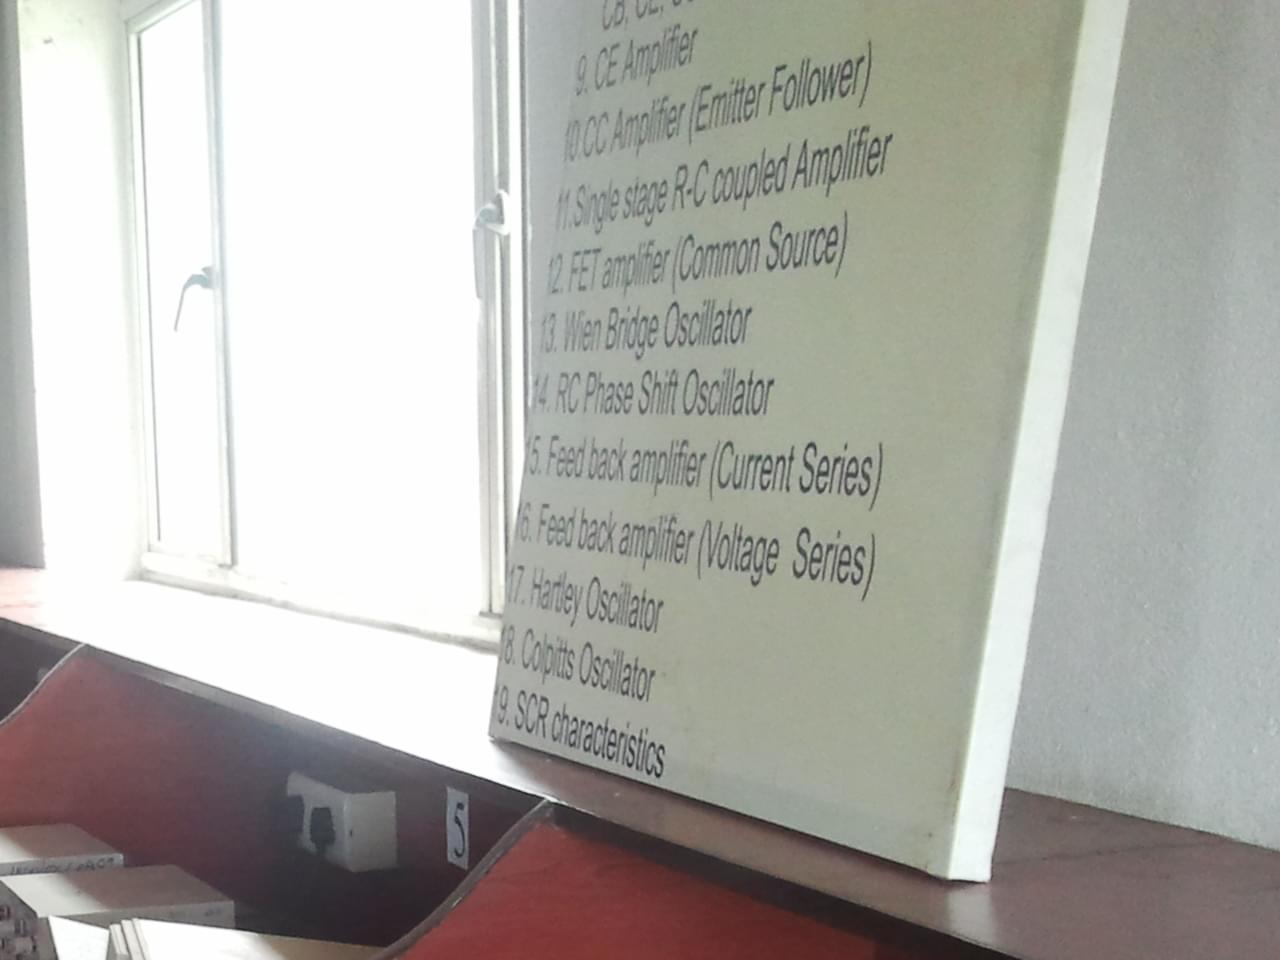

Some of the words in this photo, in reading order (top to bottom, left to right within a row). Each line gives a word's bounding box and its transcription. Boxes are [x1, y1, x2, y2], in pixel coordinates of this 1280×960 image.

[576, 55, 588, 96] 9.
[595, 44, 620, 90] CE
[622, 23, 698, 85] Amplifier
[611, 95, 686, 156] Amplifier
[689, 77, 766, 144] (Emitter
[768, 39, 872, 116] Follower)
[623, 177, 668, 227] stage
[672, 159, 709, 211] R-C
[712, 142, 791, 211] coupled
[791, 124, 894, 198] Amplifier
[568, 248, 602, 293] FET
[602, 239, 671, 296] amplifier
[672, 233, 760, 294] (Common
[765, 210, 848, 278] Source)
[564, 310, 602, 352] Wien
[605, 305, 659, 360] Bridge
[664, 299, 752, 348] Oscillator
[557, 371, 581, 414] RC
[584, 371, 633, 415] Phase
[638, 369, 678, 415] Shift
[683, 368, 775, 415] Oscillator
[546, 435, 587, 477] Feed
[588, 436, 626, 481] back
[629, 439, 708, 497] amplifier
[710, 440, 795, 501] (Current
[799, 441, 883, 512] Series)
[537, 503, 578, 548] Feed
[578, 507, 617, 554] back
[620, 514, 695, 571] amplifier
[698, 519, 780, 587] (Voltage
[792, 526, 876, 602] Series)
[529, 567, 583, 628] Hartley
[586, 576, 664, 633] Oscillator
[521, 628, 575, 684] Colpitts
[579, 641, 656, 702] Oscillator
[514, 689, 550, 738] SCR
[551, 703, 666, 778] characteristics
[454, 802, 465, 857] 5
